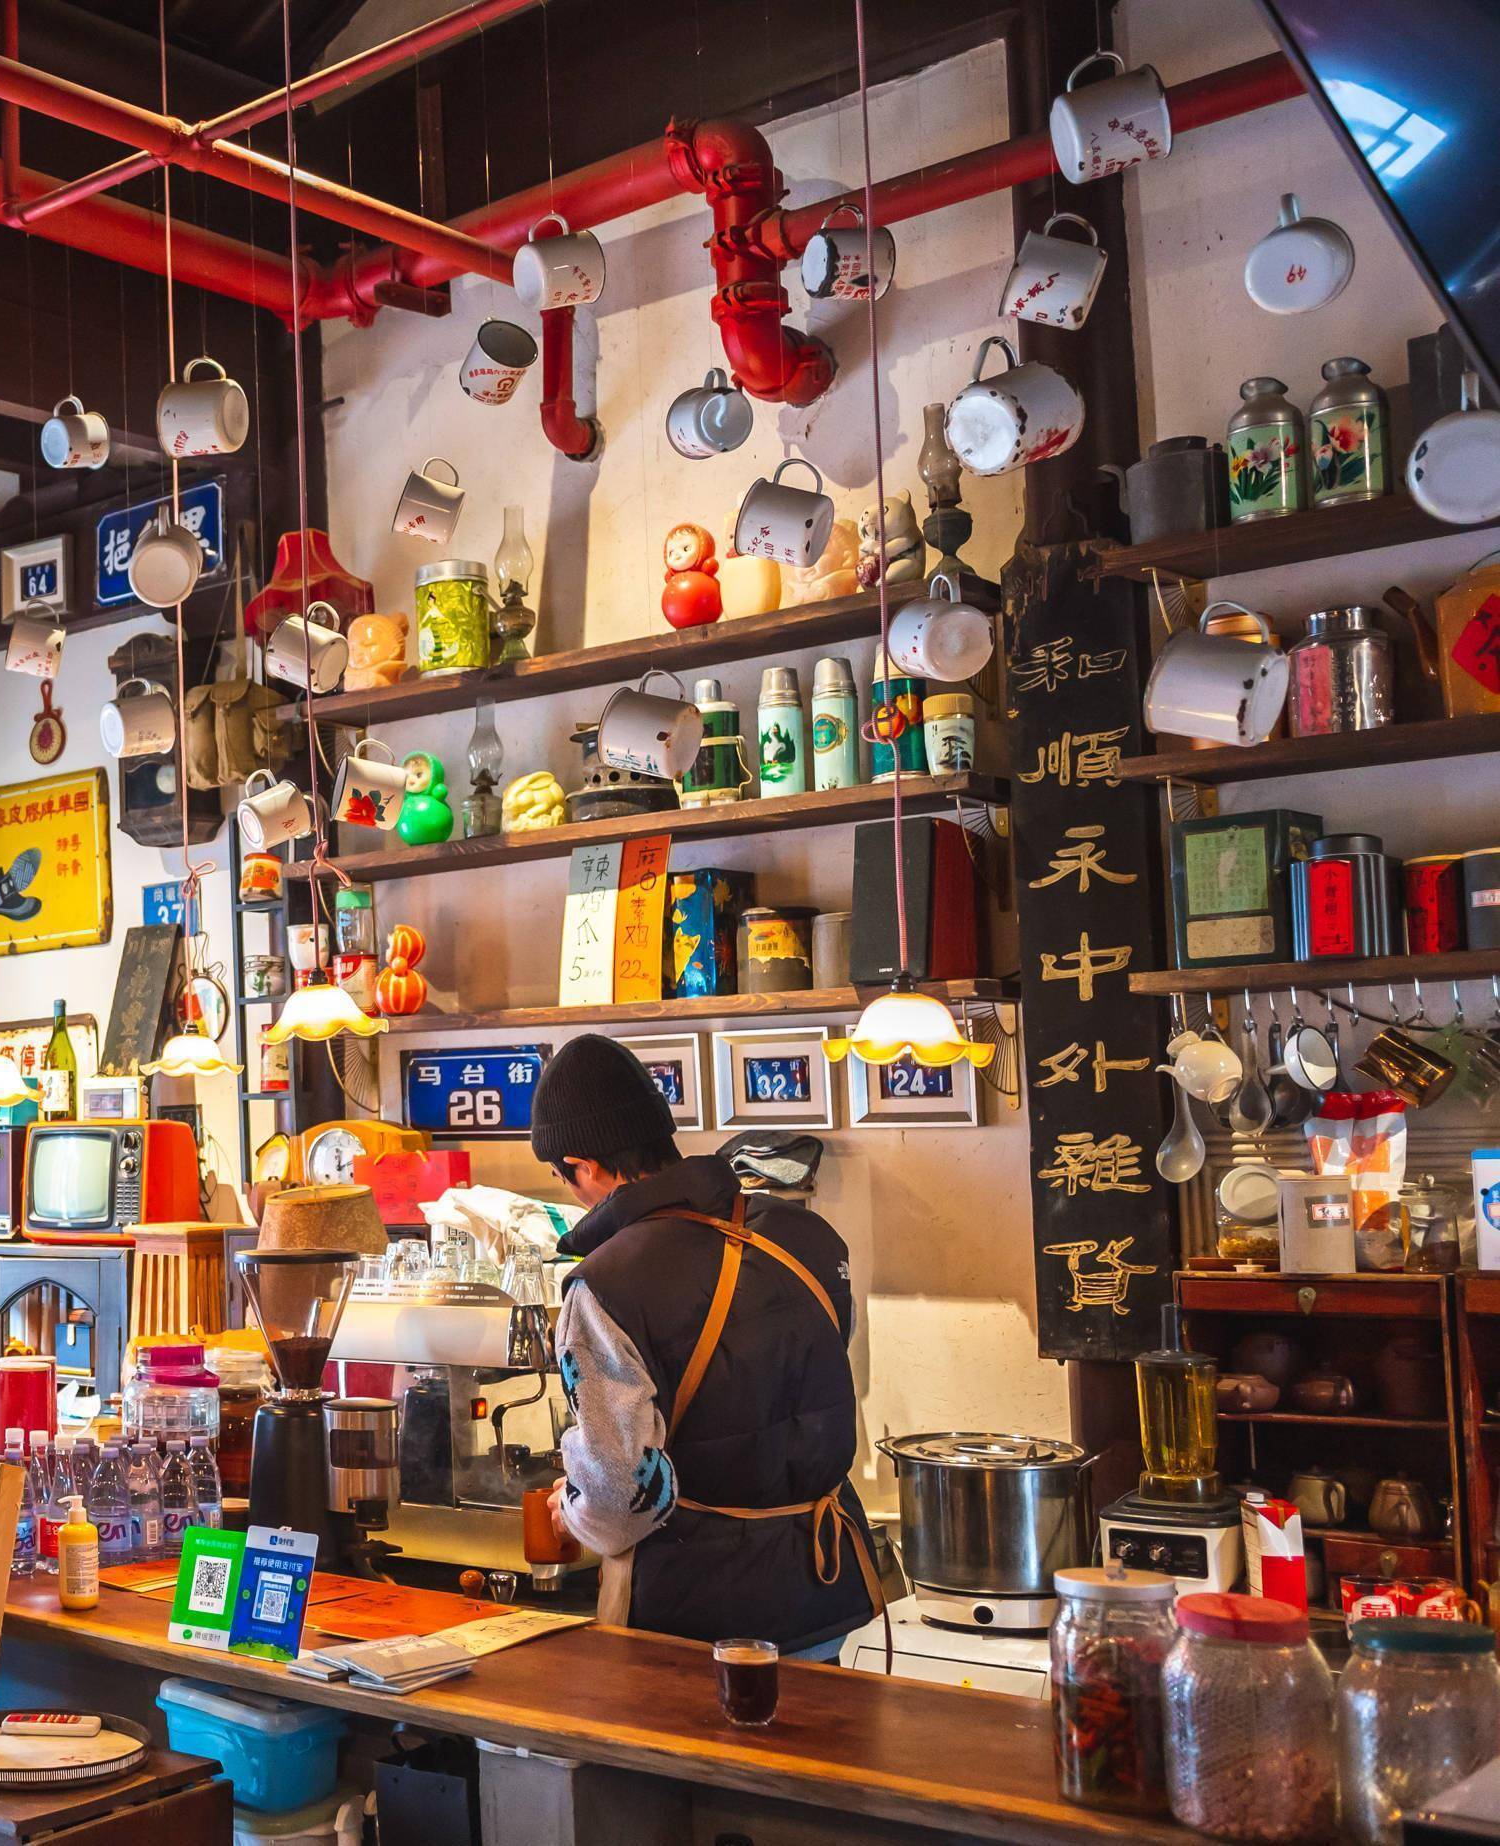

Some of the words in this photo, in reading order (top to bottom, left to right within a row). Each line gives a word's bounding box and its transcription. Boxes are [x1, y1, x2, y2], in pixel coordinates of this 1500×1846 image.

[28, 573, 47, 597] 64
[418, 1062, 534, 1086] 马台街
[892, 1068, 944, 1096] 24-1
[449, 1089, 502, 1126] 26
[252, 1556, 304, 1573] 推荐使用支付宝
